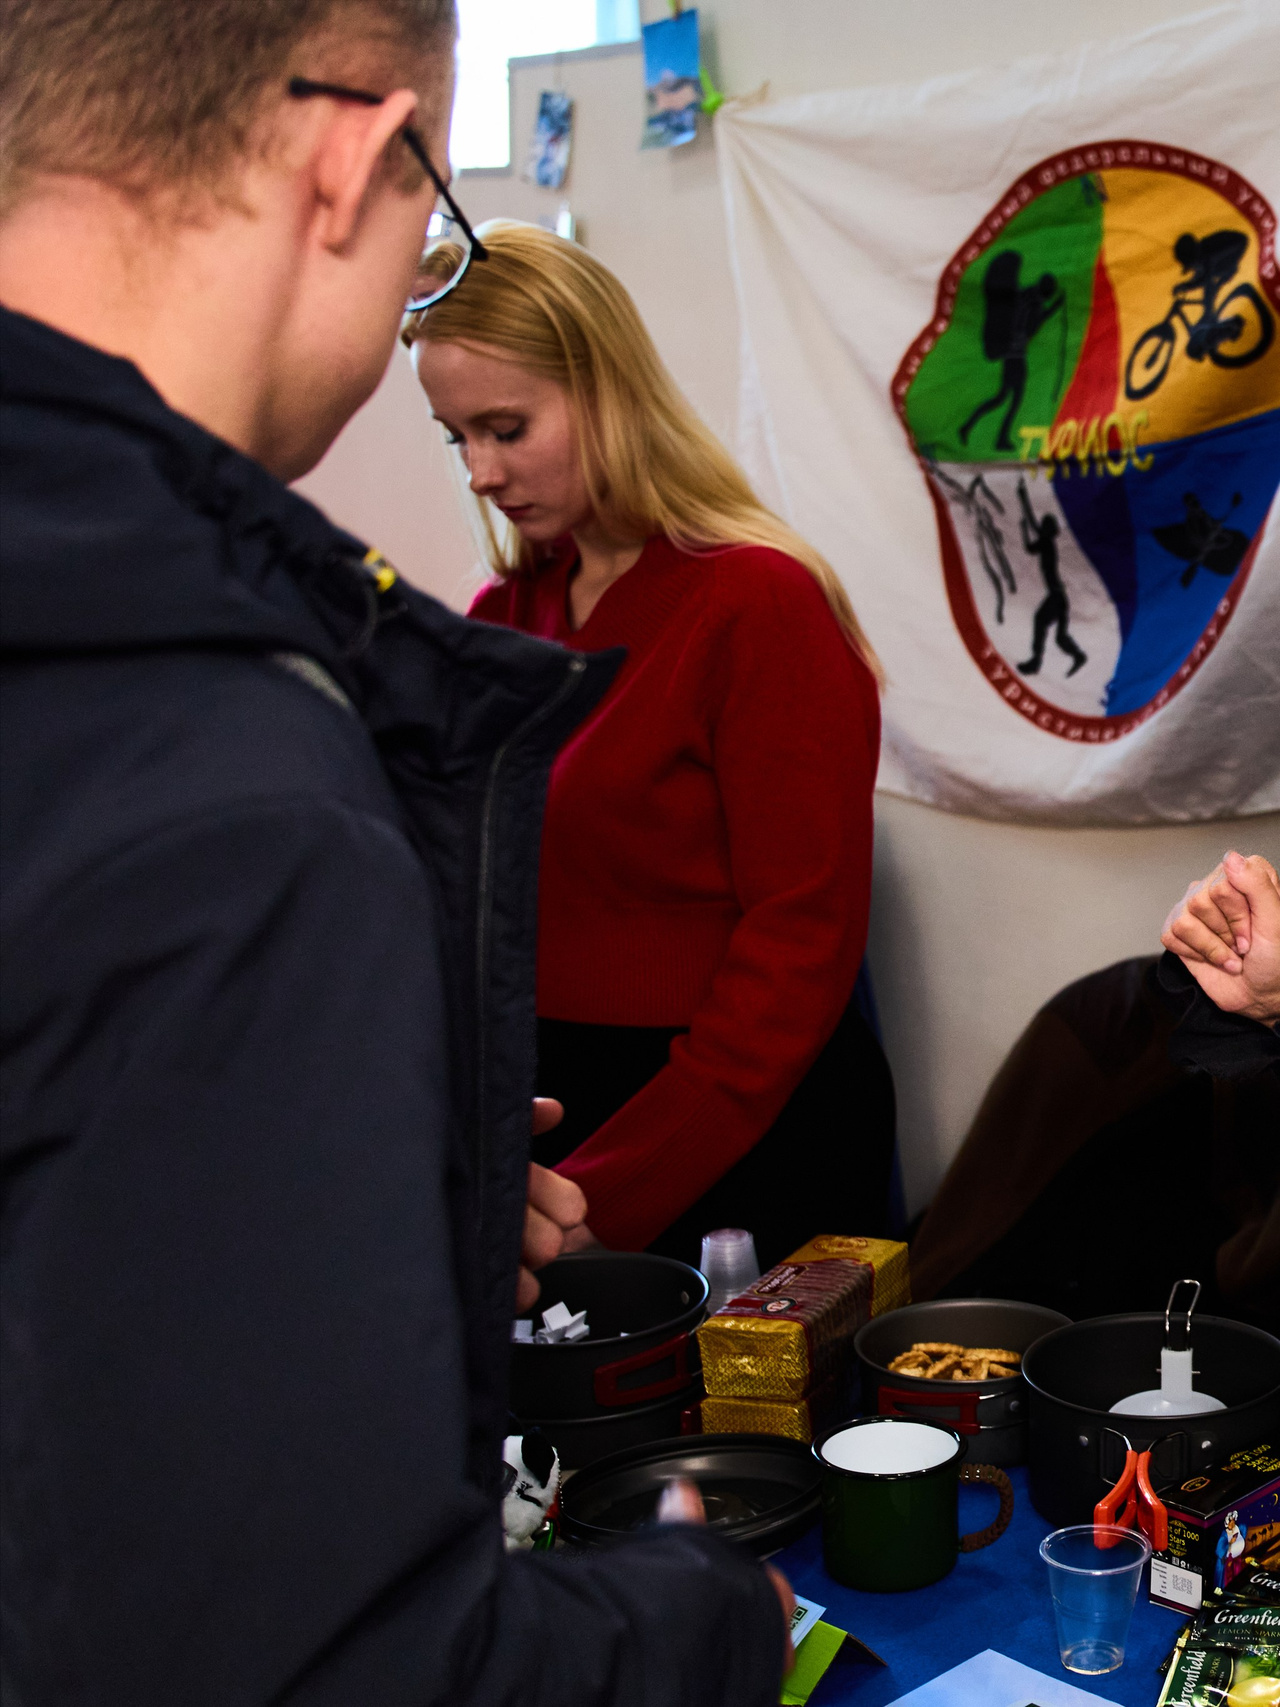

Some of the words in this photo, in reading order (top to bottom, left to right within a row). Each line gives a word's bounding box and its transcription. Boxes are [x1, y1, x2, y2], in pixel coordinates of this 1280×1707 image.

[1169, 1534, 1186, 1546] Stars
[1173, 1527, 1181, 1536] of
[1182, 1528, 1200, 1542] 1000
